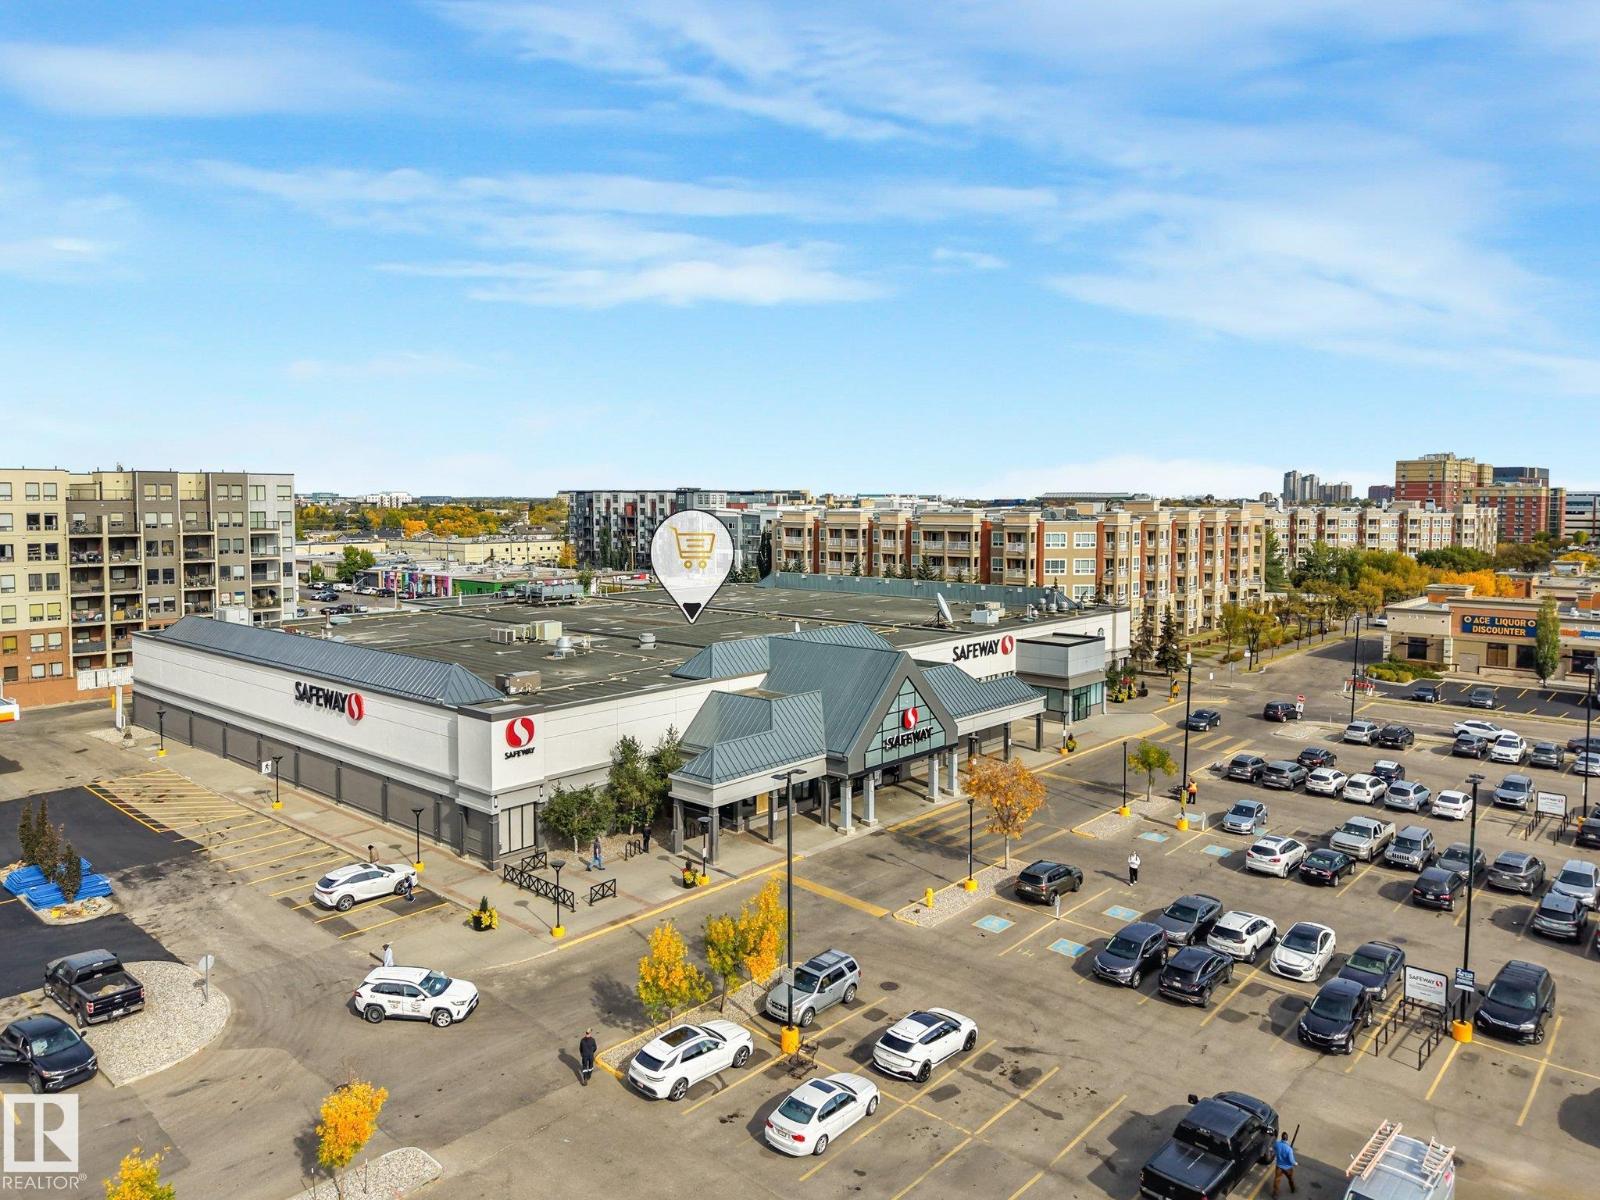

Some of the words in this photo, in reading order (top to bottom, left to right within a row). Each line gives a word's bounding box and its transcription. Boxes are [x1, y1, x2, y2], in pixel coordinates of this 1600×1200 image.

[1473, 617, 1490, 625] ACE
[1495, 617, 1526, 627] LIQUOR
[1472, 625, 1526, 636] DISCOUNTER
[952, 639, 1000, 662] SAFEWAY
[295, 681, 348, 713] SAFEWAY
[885, 726, 933, 749] SAFEWAY
[505, 747, 535, 760] SAFEWAY
[1408, 974, 1435, 984] SAFEWAY
